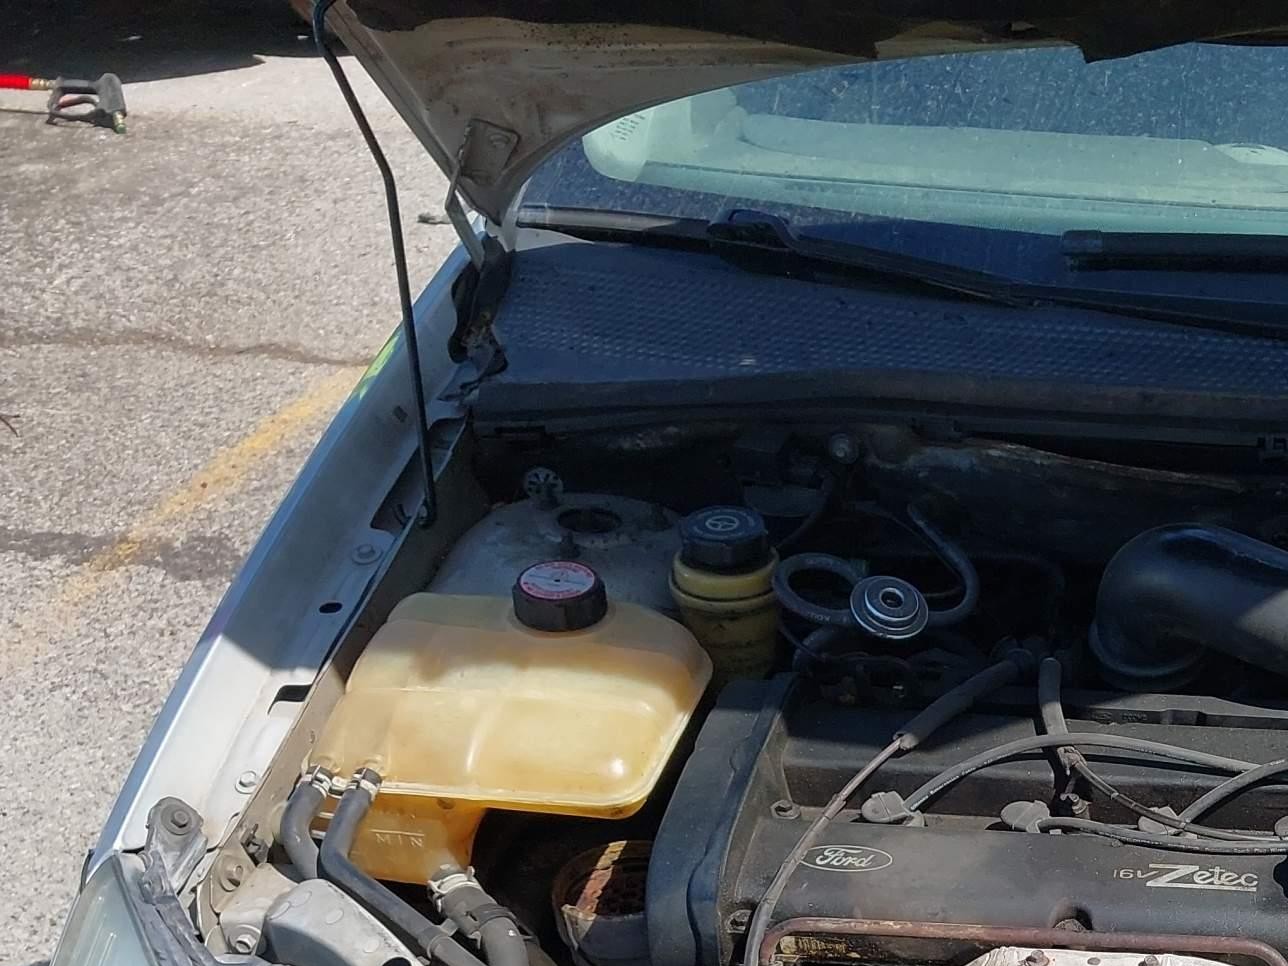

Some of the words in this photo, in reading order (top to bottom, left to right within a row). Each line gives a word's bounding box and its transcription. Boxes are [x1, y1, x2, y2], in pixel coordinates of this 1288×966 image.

[376, 832, 423, 848] MIN
[815, 847, 876, 867] Ford
[1146, 863, 1259, 892] Zetec
